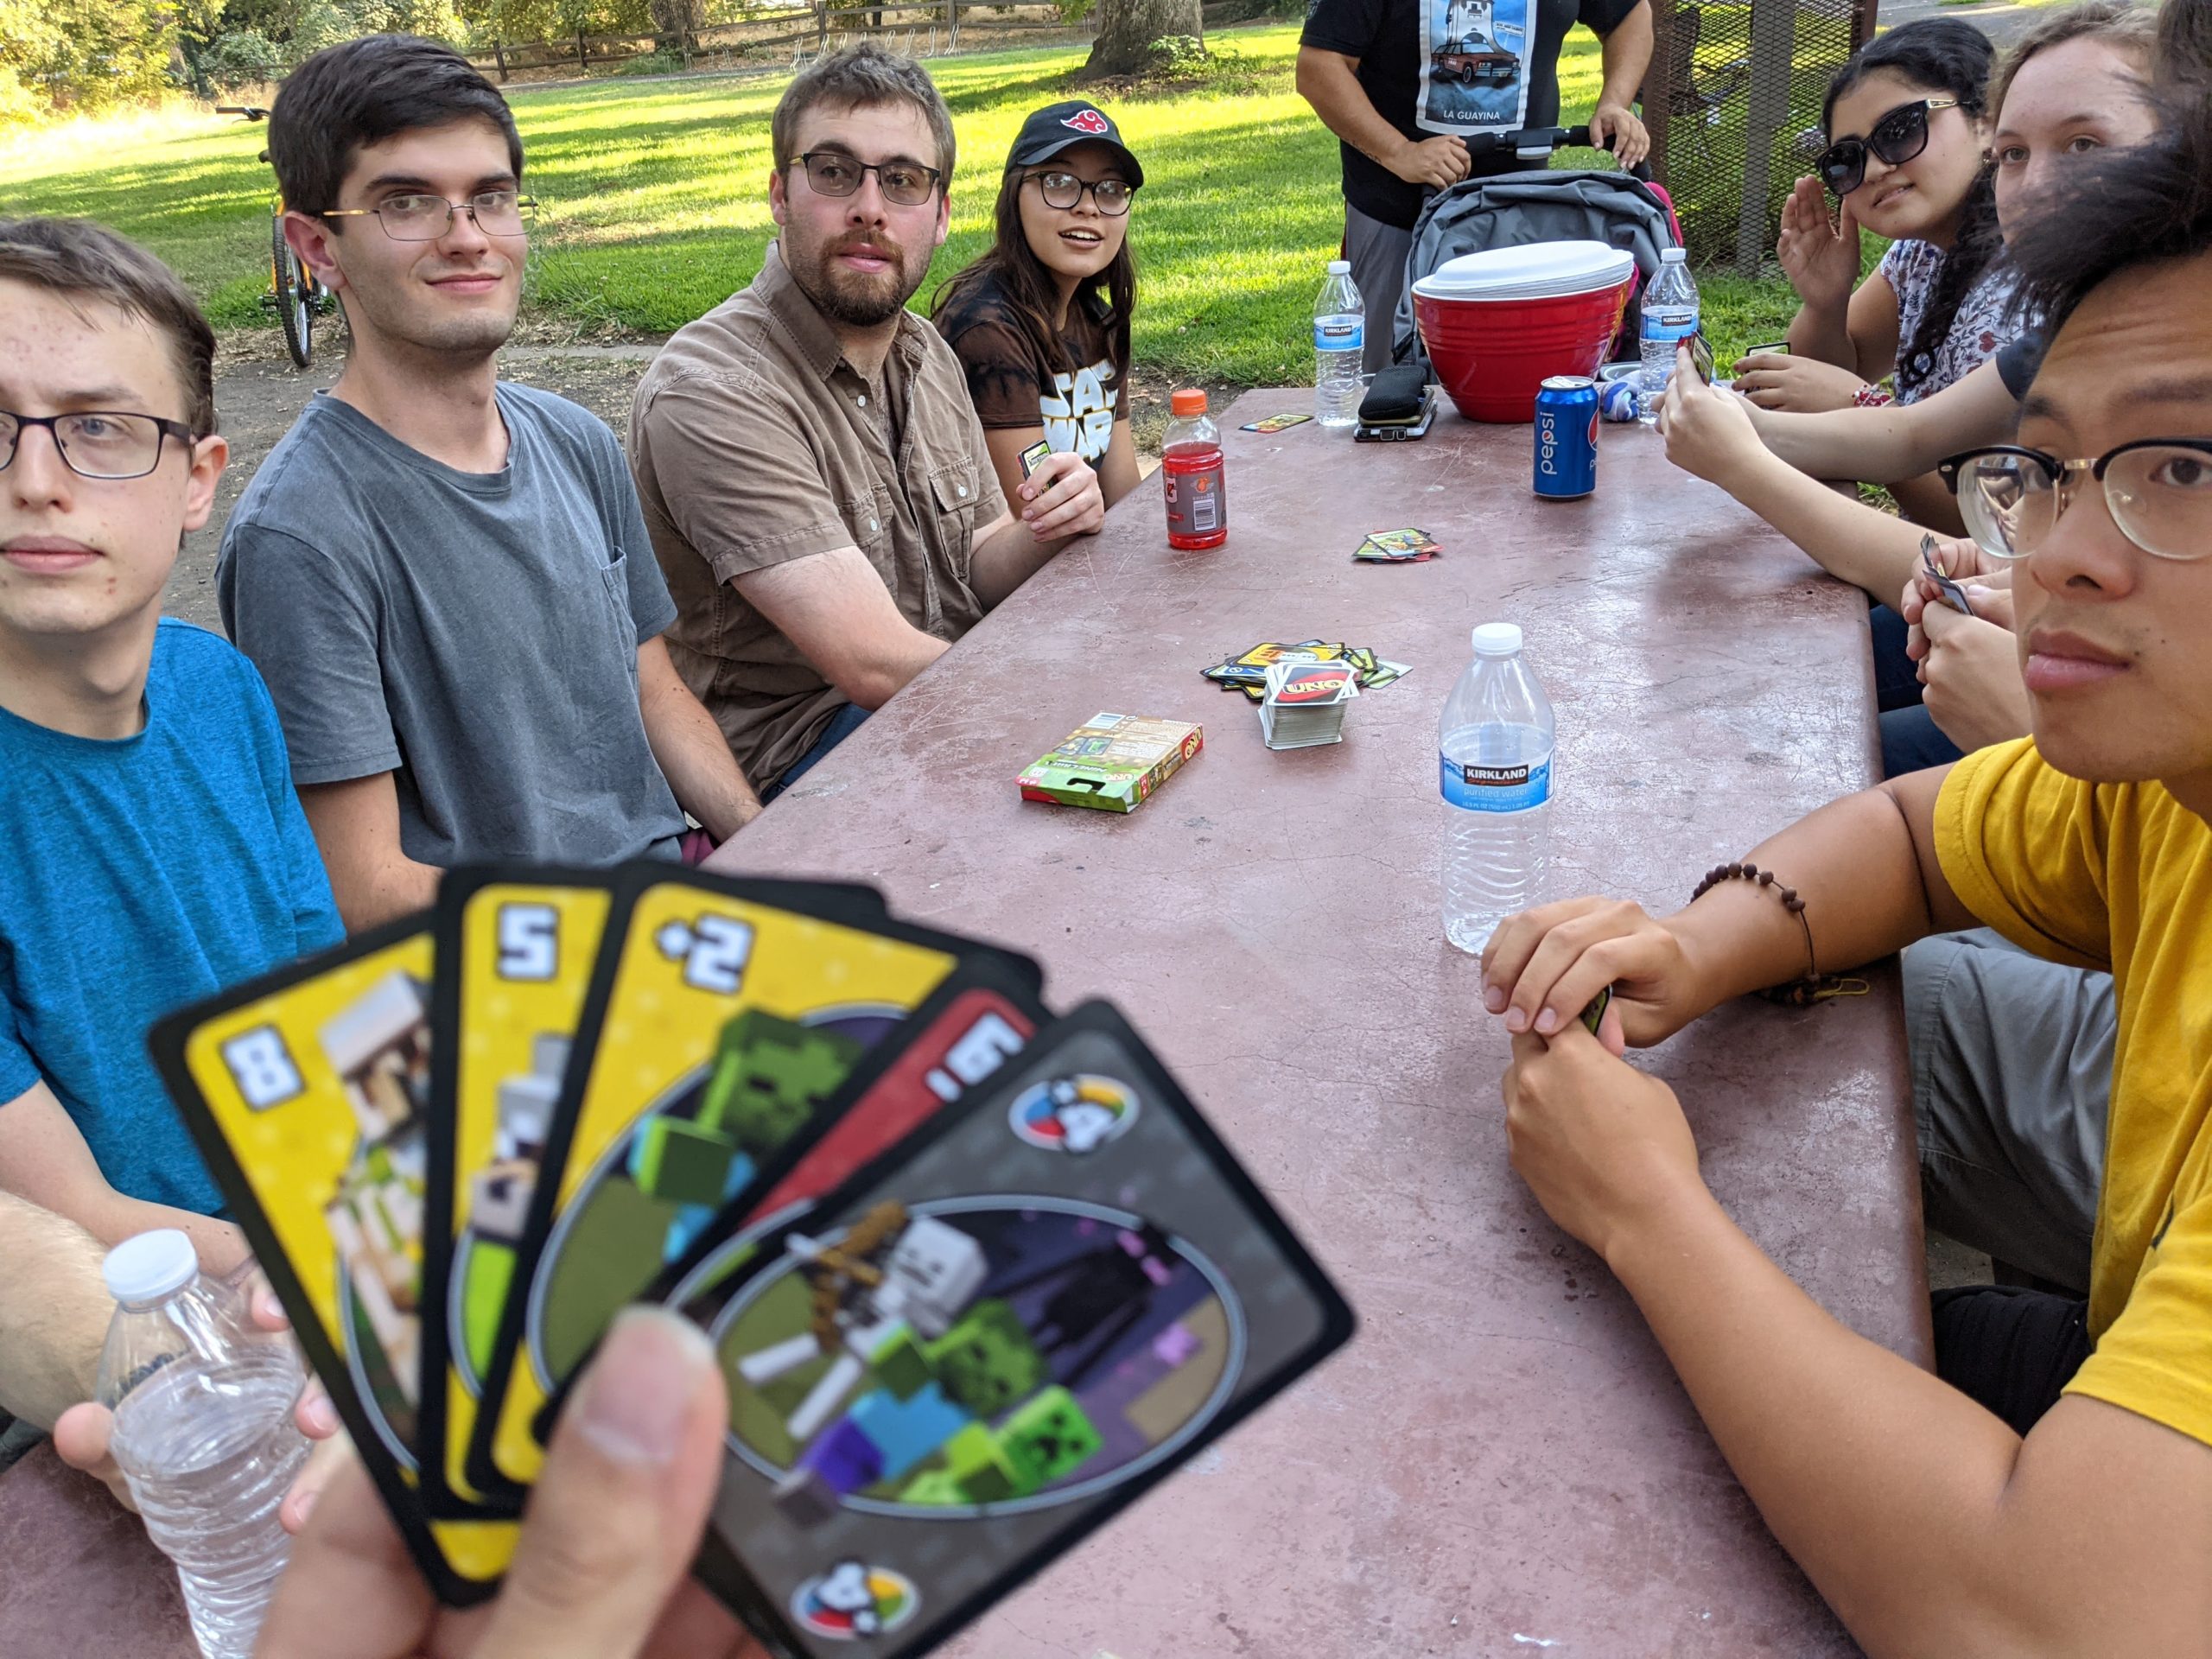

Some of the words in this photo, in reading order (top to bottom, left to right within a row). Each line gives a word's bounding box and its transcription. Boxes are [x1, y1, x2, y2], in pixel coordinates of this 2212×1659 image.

[1443, 110, 1454, 119] LA
[1457, 111, 1500, 120] GUAYINA
[1541, 411, 1558, 475] pepsi
[1283, 679, 1346, 694] UNO
[1185, 726, 1203, 760] UNO
[1466, 767, 1527, 780] KIRKLAND
[1464, 787, 1499, 798] purified
[1501, 787, 1528, 798] water
[496, 902, 559, 980] 5
[654, 912, 755, 995] +2
[221, 1023, 303, 1112] 8
